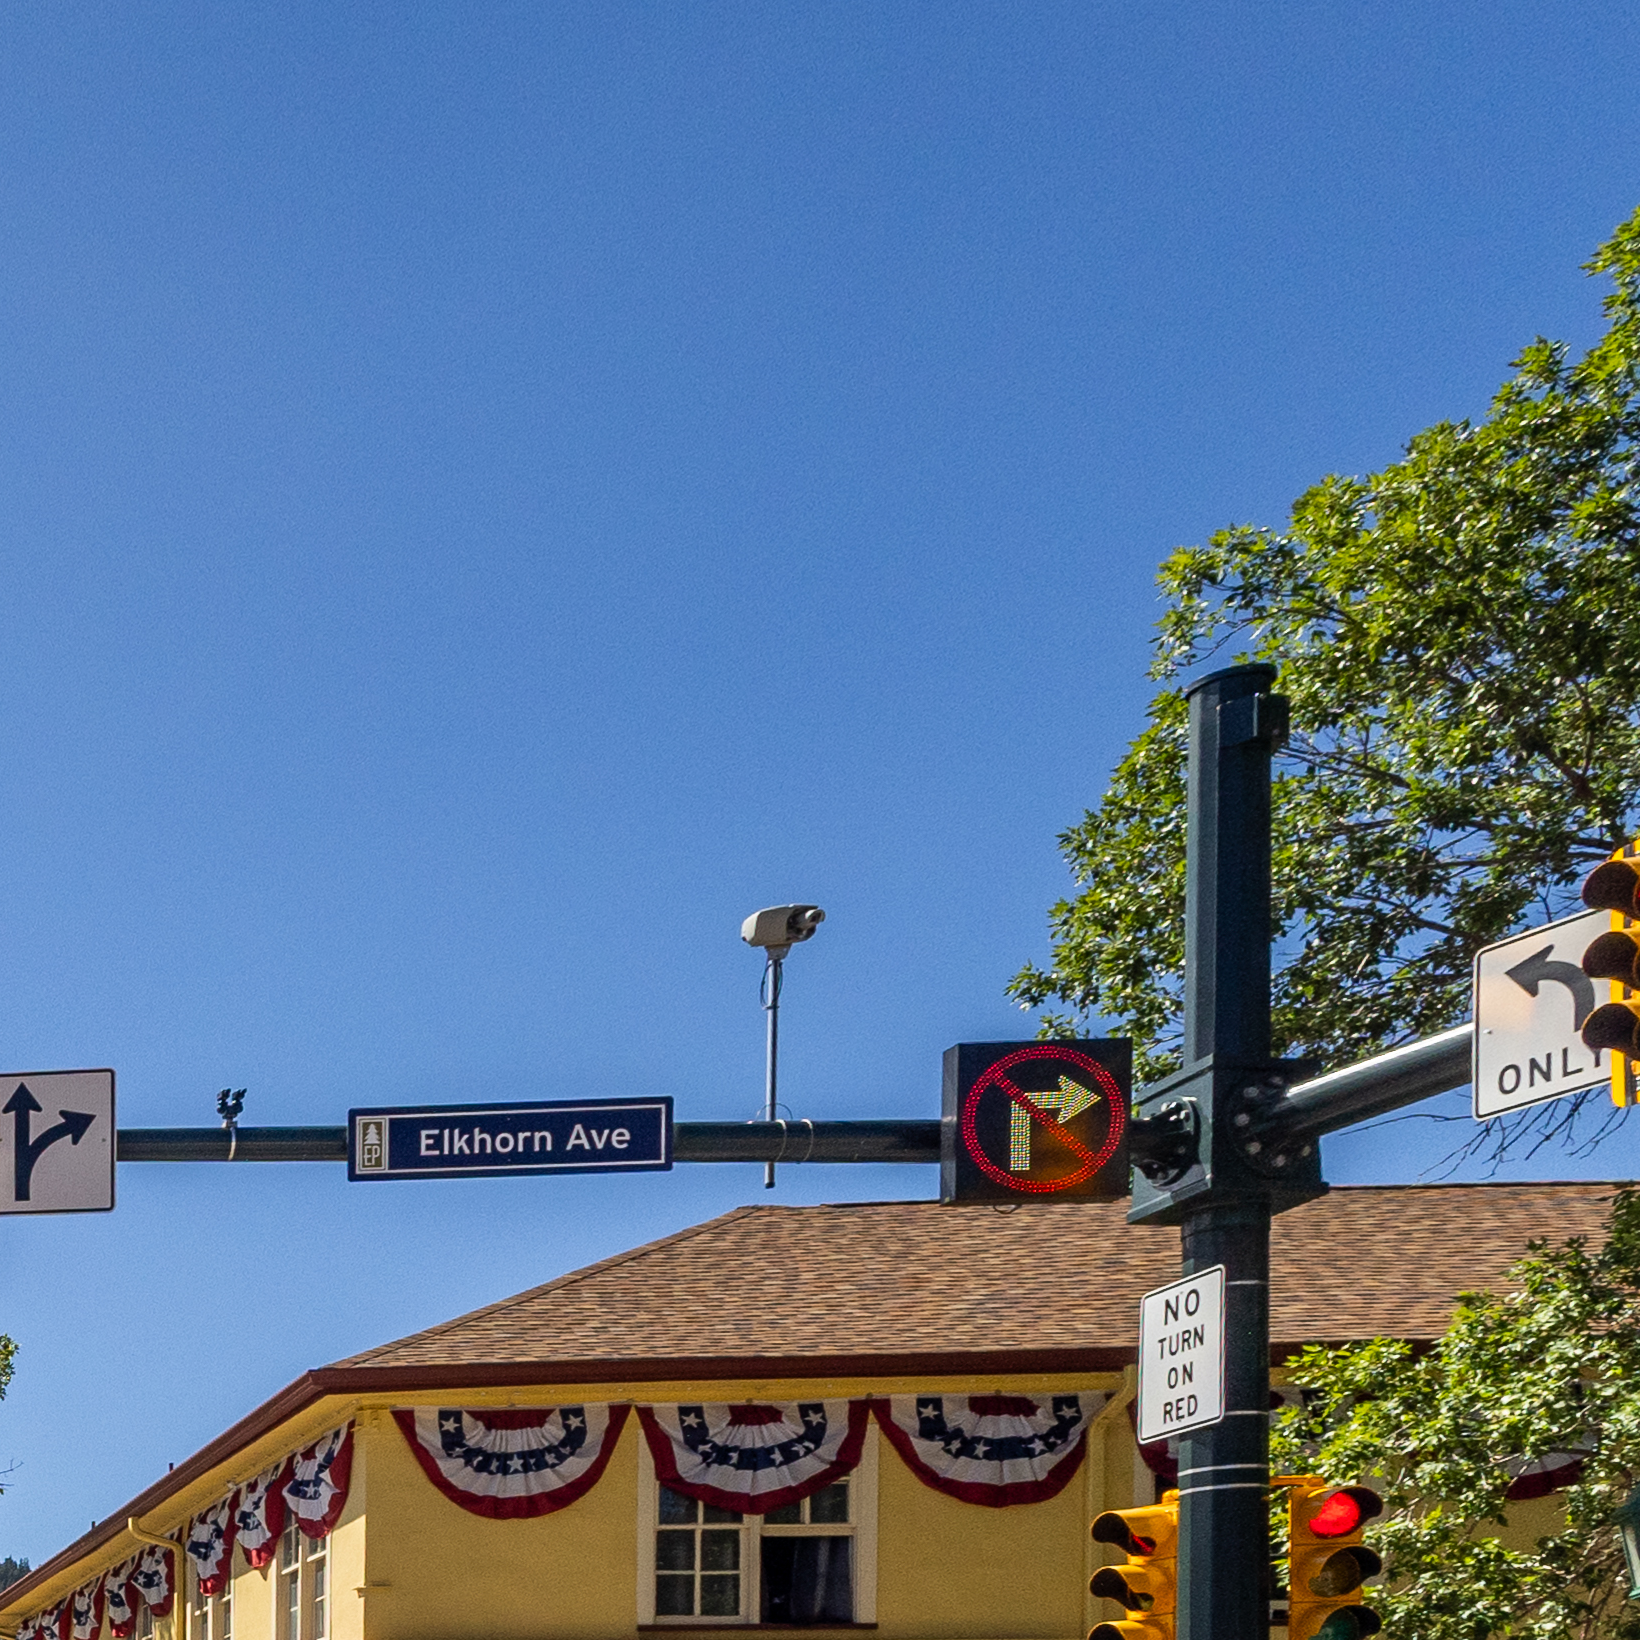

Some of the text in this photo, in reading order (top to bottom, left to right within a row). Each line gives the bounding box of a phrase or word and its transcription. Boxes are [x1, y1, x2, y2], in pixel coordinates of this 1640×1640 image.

[420, 1123, 630, 1156] Elkhorn Ave
[1164, 1289, 1200, 1326] NO
[1158, 1324, 1205, 1360] TURN
[1167, 1361, 1193, 1389] ON
[1163, 1394, 1198, 1424] RED
